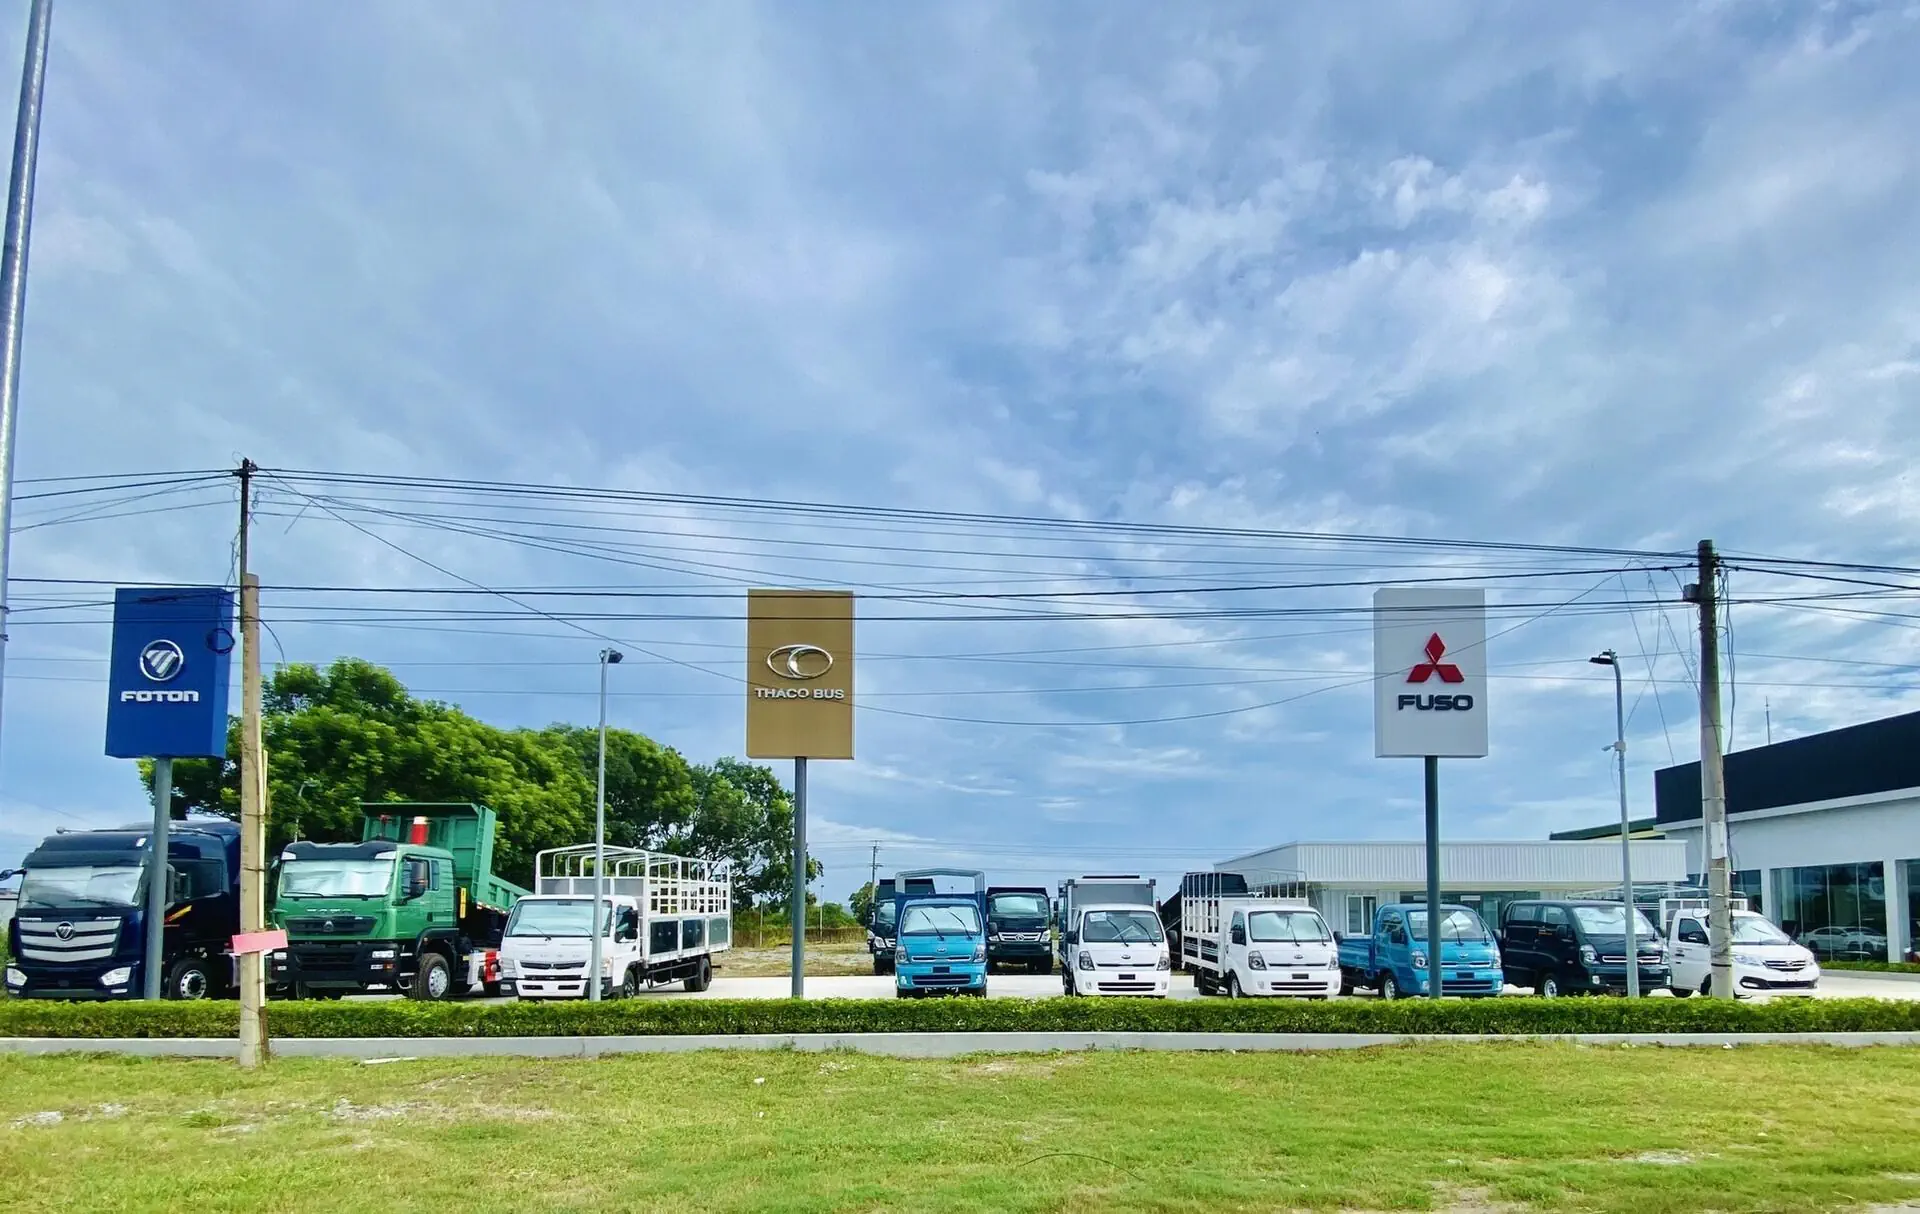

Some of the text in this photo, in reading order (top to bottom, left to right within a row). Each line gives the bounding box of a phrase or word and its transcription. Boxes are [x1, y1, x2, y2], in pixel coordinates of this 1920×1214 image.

[120, 690, 199, 702] FOTON
[755, 688, 844, 699] THACO BUS
[1398, 694, 1473, 711] FUSO
